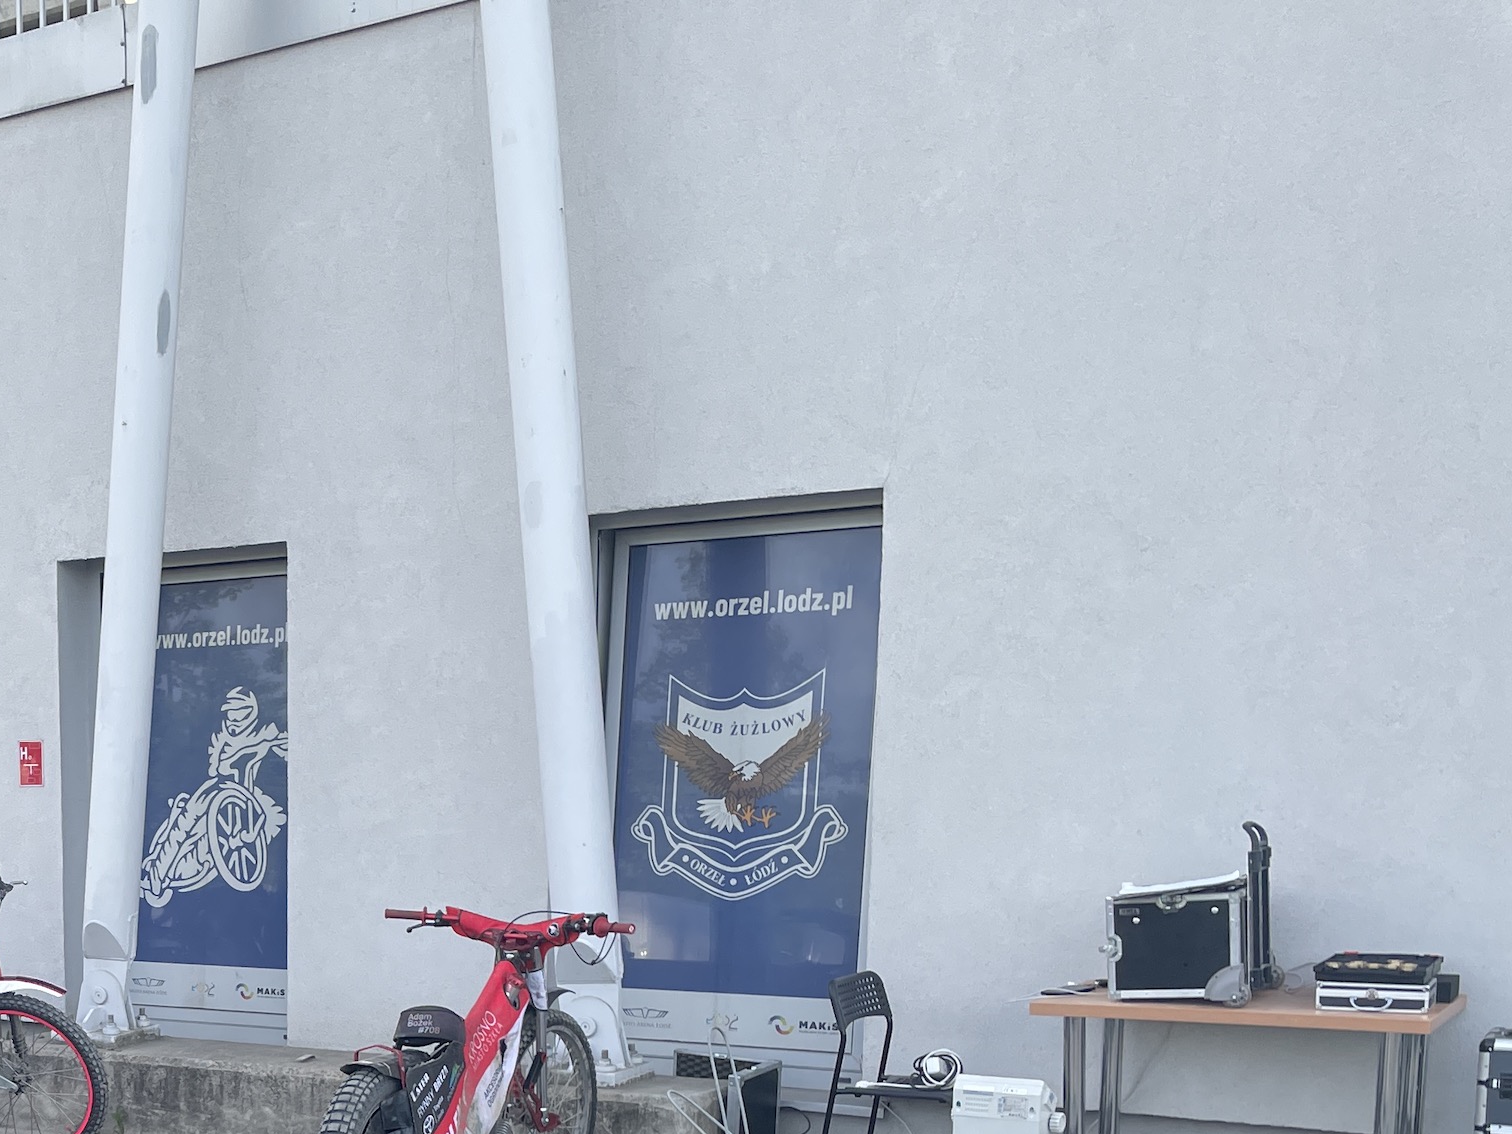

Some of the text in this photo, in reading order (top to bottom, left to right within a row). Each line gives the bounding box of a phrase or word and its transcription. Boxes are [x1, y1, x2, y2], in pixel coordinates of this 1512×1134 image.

[654, 585, 853, 622] www.orzel.lodz.pl
[682, 708, 807, 737] KLUB ŻUŻLOWY
[690, 857, 779, 886] ORZEŁ ŁÓDŹ
[407, 1019, 432, 1027] Bożek
[409, 1013, 432, 1021] Adam
